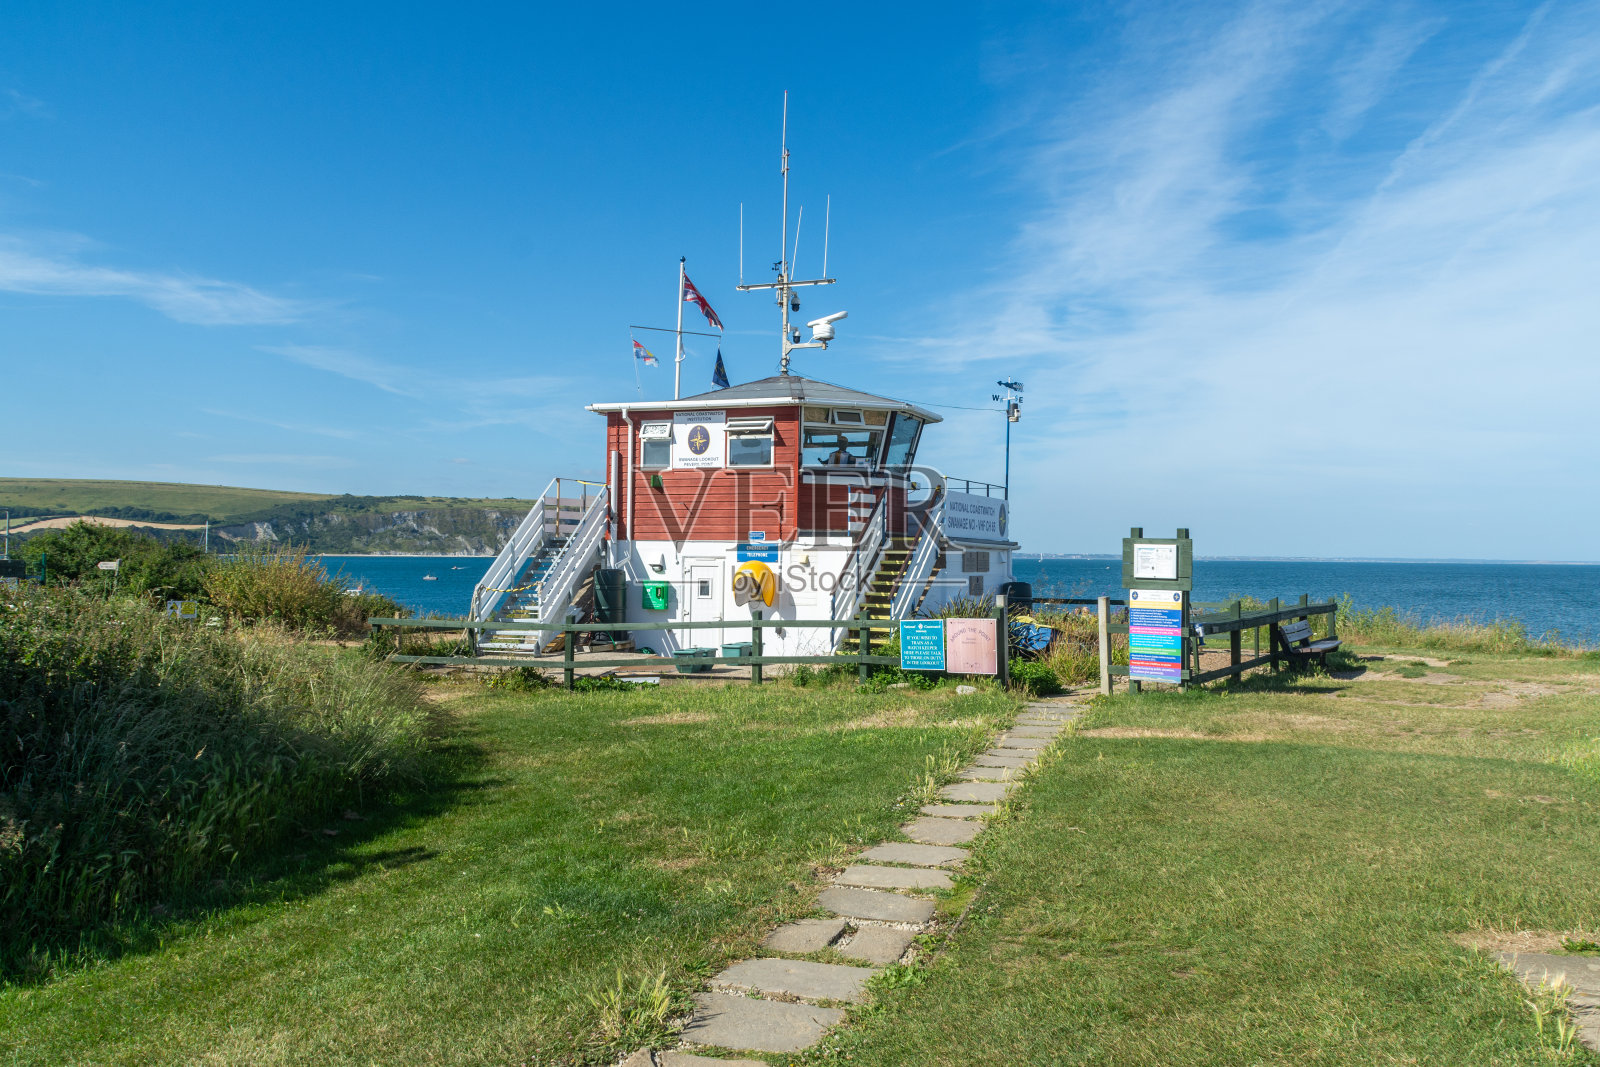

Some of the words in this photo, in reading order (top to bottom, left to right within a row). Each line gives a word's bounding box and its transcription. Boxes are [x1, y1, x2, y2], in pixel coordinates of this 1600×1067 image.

[950, 501, 970, 513] NATIONAL
[970, 504, 995, 516] COASTWATCH
[948, 516, 968, 530] SWANAGE
[979, 629, 991, 641] POINT
